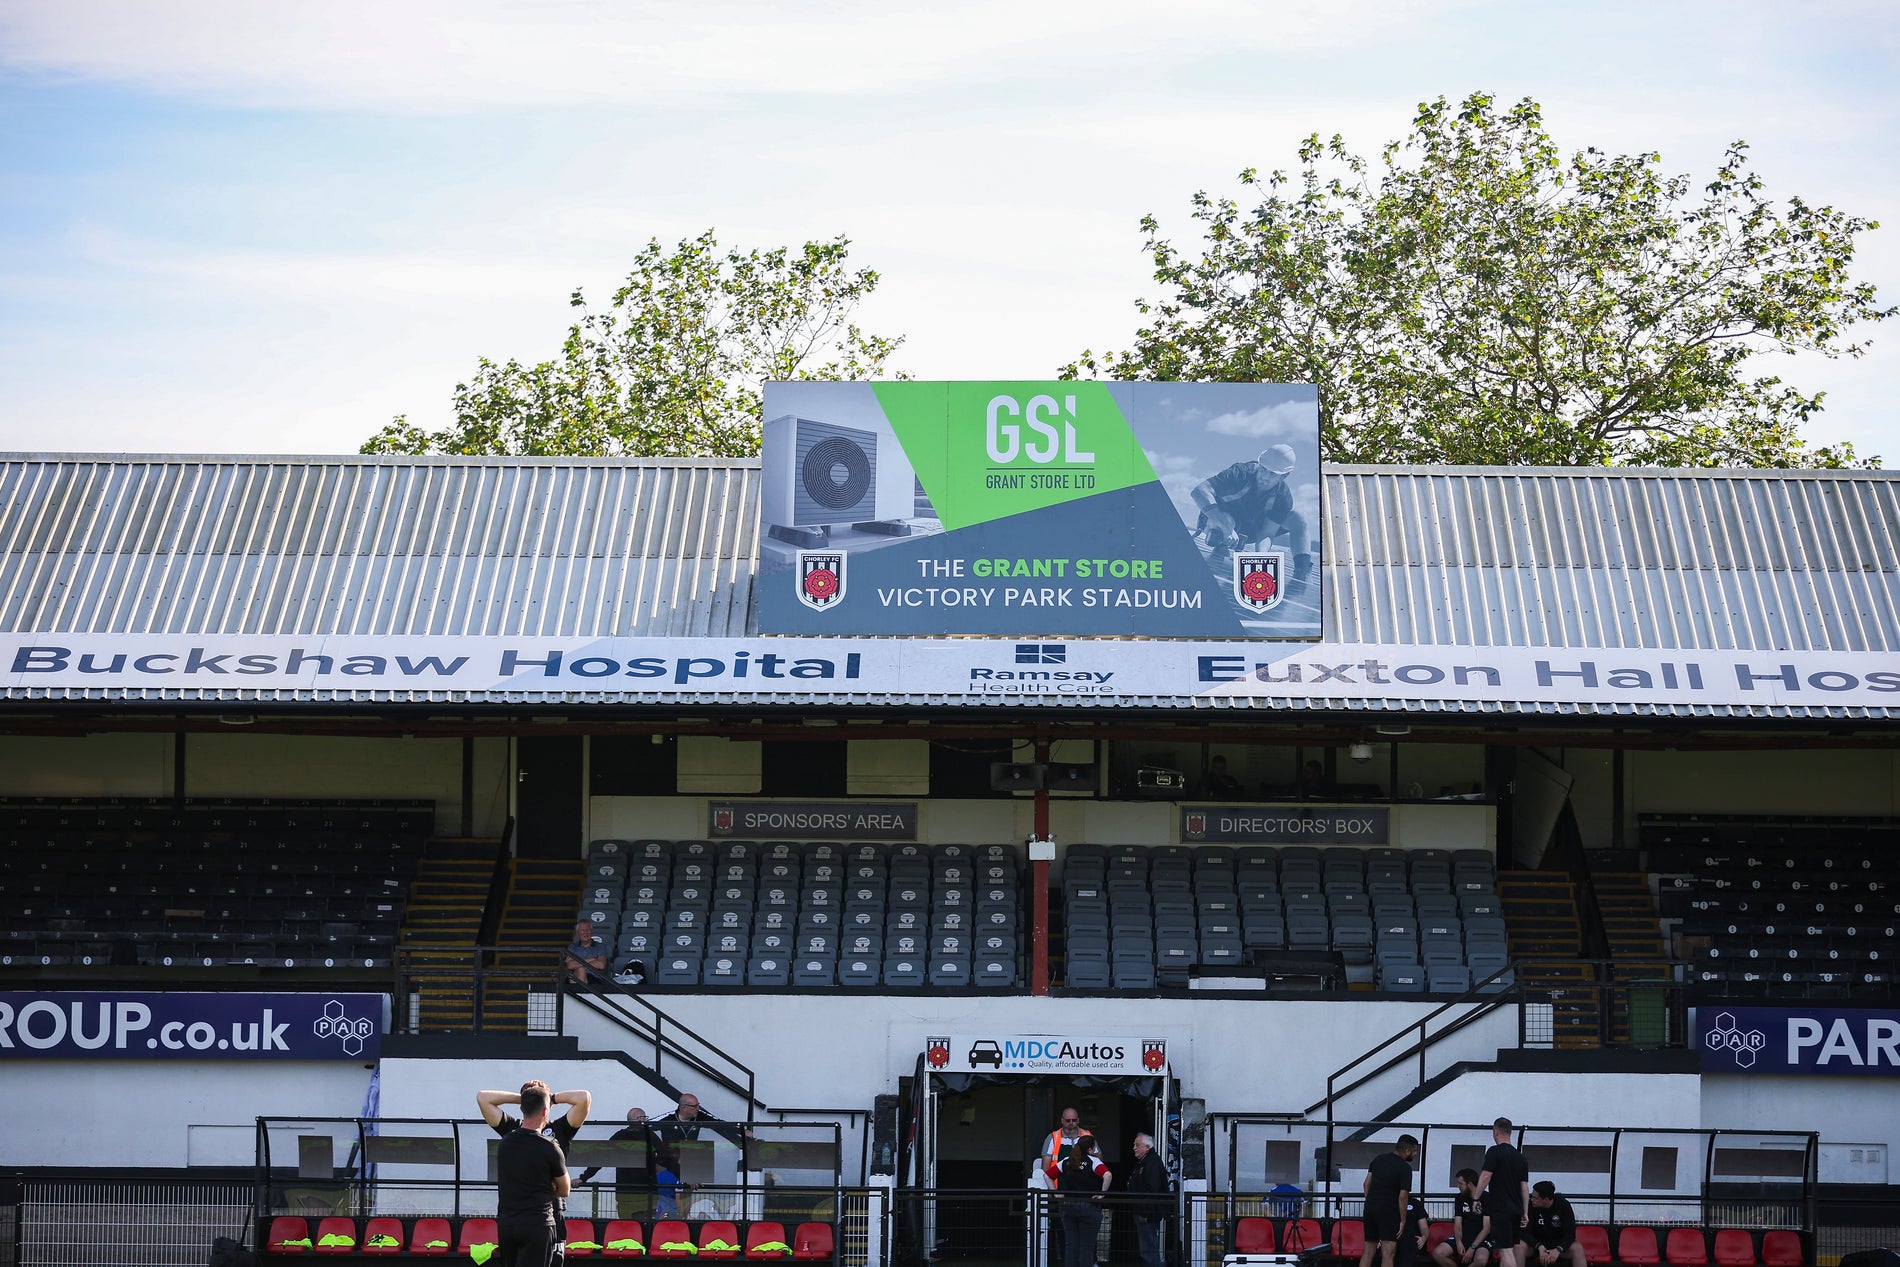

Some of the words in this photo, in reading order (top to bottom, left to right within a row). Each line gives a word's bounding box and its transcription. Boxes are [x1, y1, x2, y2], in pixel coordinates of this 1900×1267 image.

[986, 394, 1095, 463] GSL
[986, 475, 1026, 489] GRANT
[1030, 475, 1069, 489] STORE
[1074, 475, 1095, 489] LTD
[917, 559, 965, 578] THE
[972, 558, 1069, 578] GRANT
[1075, 559, 1163, 579] STORE
[877, 588, 996, 607] VICTORY
[1004, 588, 1073, 607] PARK
[1082, 588, 1202, 609] STADIUM
[10, 646, 471, 676] Buckshaw
[499, 650, 861, 685] Hospital
[1197, 656, 1502, 686] Euxton
[1535, 660, 1704, 690] Hall
[970, 668, 1114, 684] Ramsay
[969, 683, 1049, 692] Health
[1057, 683, 1114, 693] Care
[744, 813, 851, 828] SPONSORS'
[854, 814, 905, 829] AREA
[1219, 818, 1330, 834] DIRECTORS'
[1335, 819, 1374, 834] BOX
[1005, 1041, 1125, 1060] MDCAutos
[1787, 1017, 1900, 1066] PAR
[1028, 1060, 1054, 1069] Quality,
[1055, 1060, 1091, 1068] affordable
